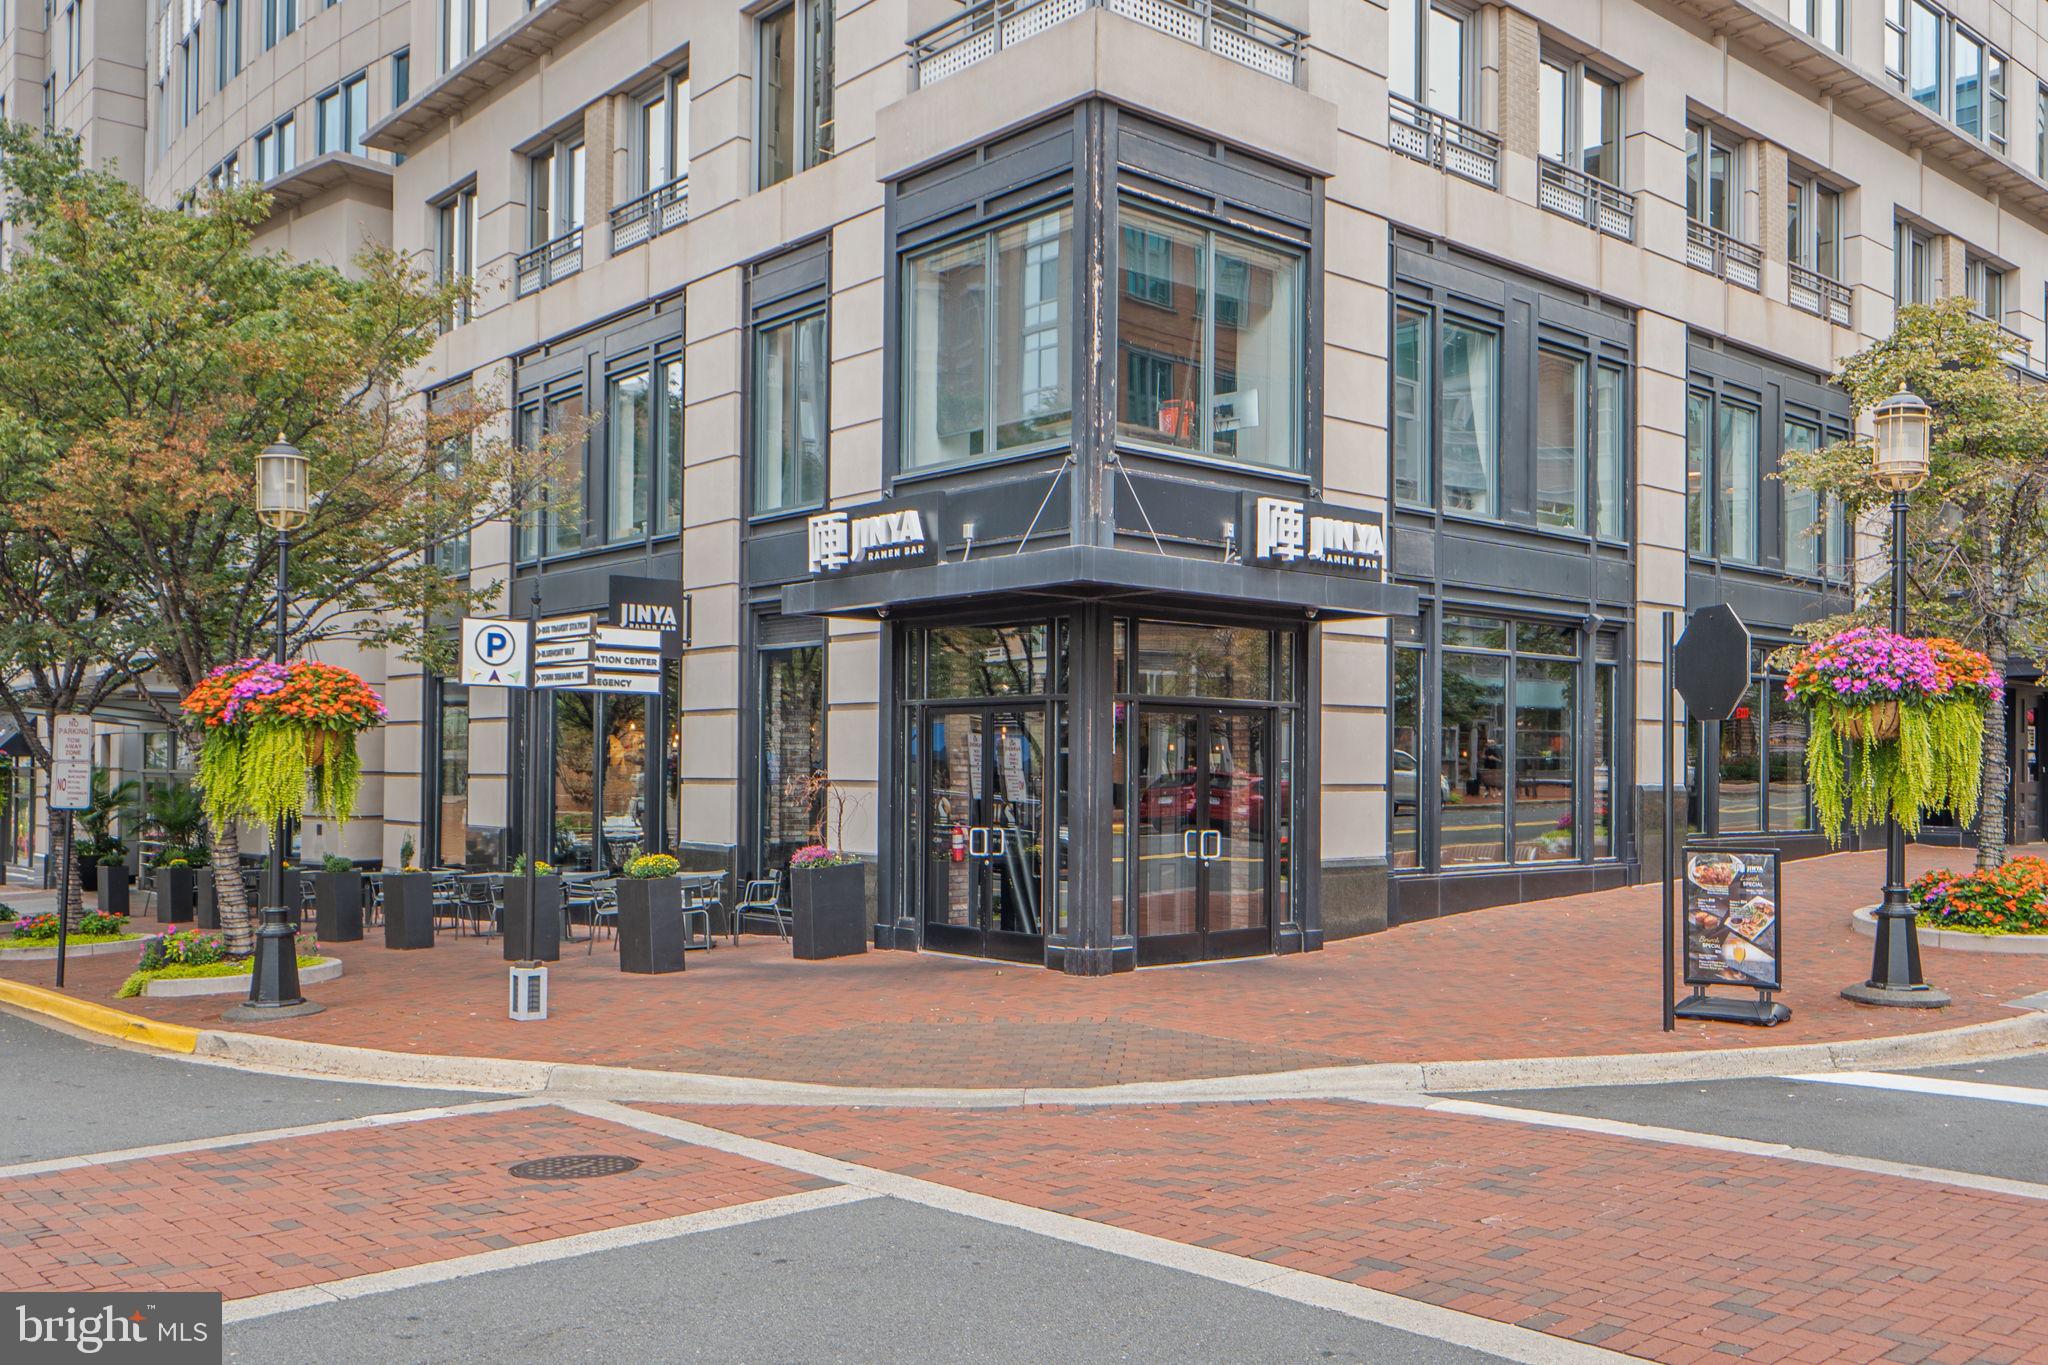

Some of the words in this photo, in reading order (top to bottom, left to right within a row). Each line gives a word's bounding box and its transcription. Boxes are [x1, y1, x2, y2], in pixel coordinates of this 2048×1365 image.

[850, 510, 925, 562] JINYA
[1308, 516, 1384, 560] JINYA
[868, 548, 900, 561] RAMEN
[904, 544, 925, 555] BAR
[1320, 553, 1354, 567] RAMEN
[1358, 557, 1378, 569] BAR
[619, 602, 677, 627] JINYA
[487, 632, 507, 658] P
[592, 655, 621, 664] ATION
[624, 656, 657, 667] CENTER
[58, 727, 89, 735] PARKING
[68, 720, 79, 728] NO
[57, 778, 67, 792] NO
[1702, 942, 1722, 950] SPECIAL
